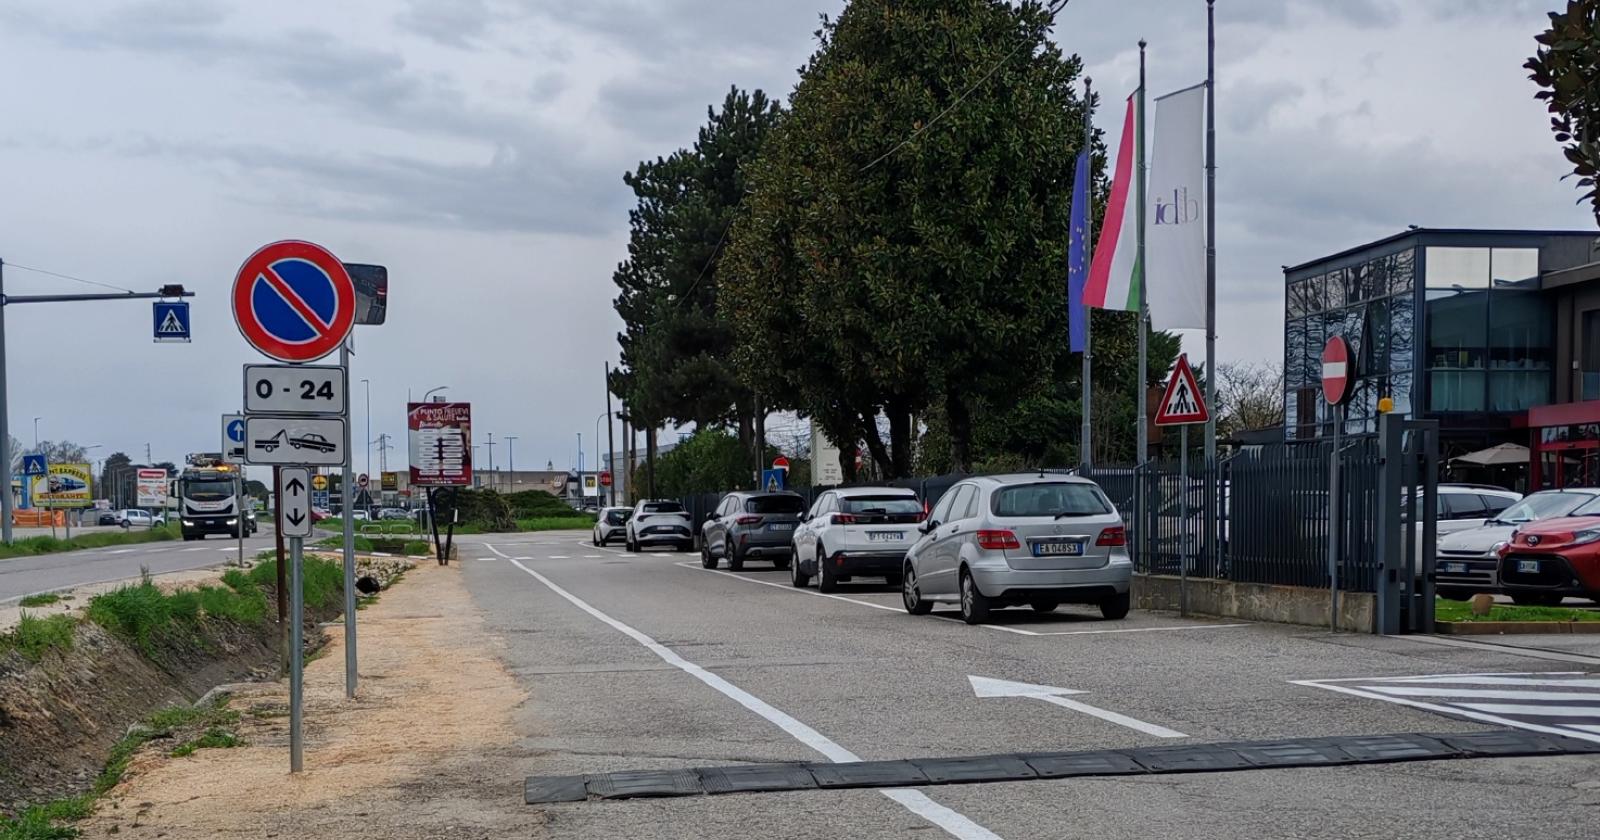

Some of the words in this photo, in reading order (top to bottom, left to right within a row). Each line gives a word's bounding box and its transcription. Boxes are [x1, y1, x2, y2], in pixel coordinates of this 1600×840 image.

[255, 379, 273, 399] 0
[300, 380, 334, 400] 24
[420, 408, 443, 416] PUNTO
